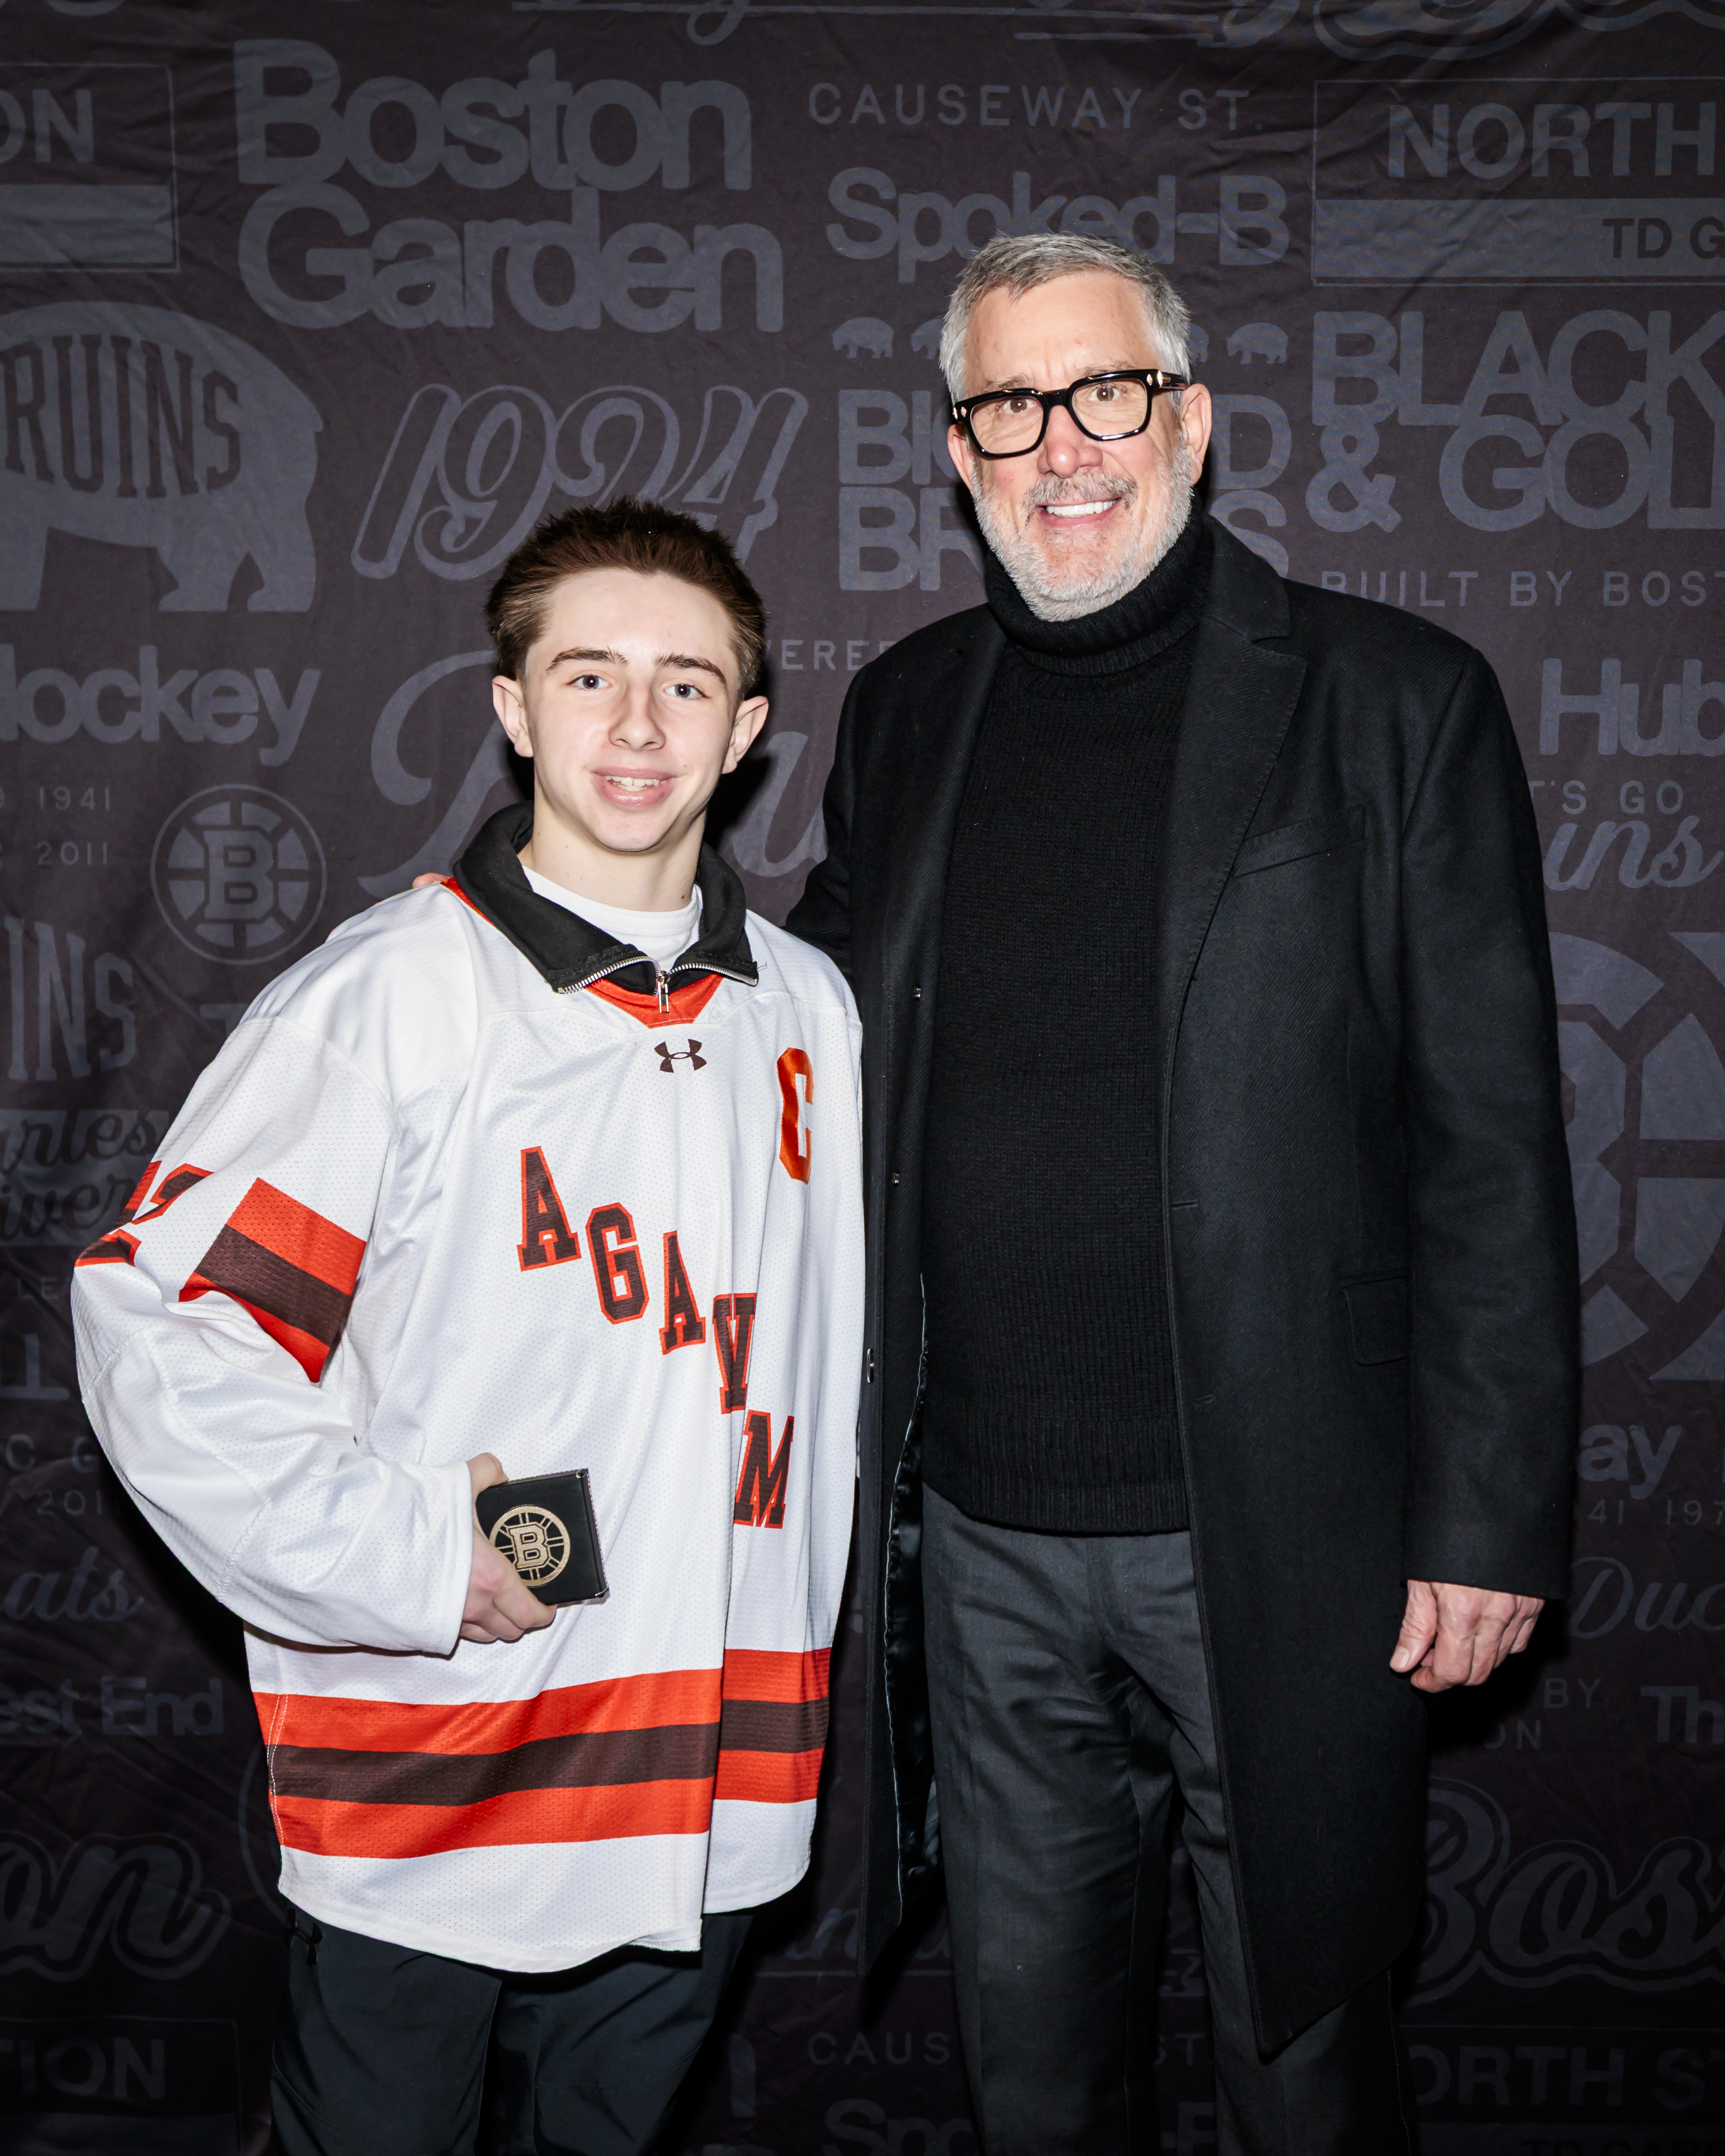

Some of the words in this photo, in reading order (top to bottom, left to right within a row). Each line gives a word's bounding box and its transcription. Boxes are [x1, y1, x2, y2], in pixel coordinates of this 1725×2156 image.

[232, 38, 752, 191] Boston
[808, 83, 1142, 129] CAUSEWAY
[1177, 89, 1264, 131] ST.
[1387, 101, 1717, 179] NORTH
[825, 166, 1290, 284] Spoked-B
[1601, 218, 1672, 259] TD
[237, 182, 784, 333] Garden
[1311, 309, 1725, 426] BLACK
[350, 383, 809, 579] 1924
[1305, 414, 1403, 533] &
[1510, 571, 1573, 607] BY
[0, 644, 322, 768] ockey
[39, 786, 110, 811] 1941
[1619, 780, 1684, 815] GO
[36, 841, 108, 867] 2011
[101, 1676, 225, 1737] End
[1543, 1678, 1601, 1710] BY
[807, 2032, 950, 2066] CAUS
